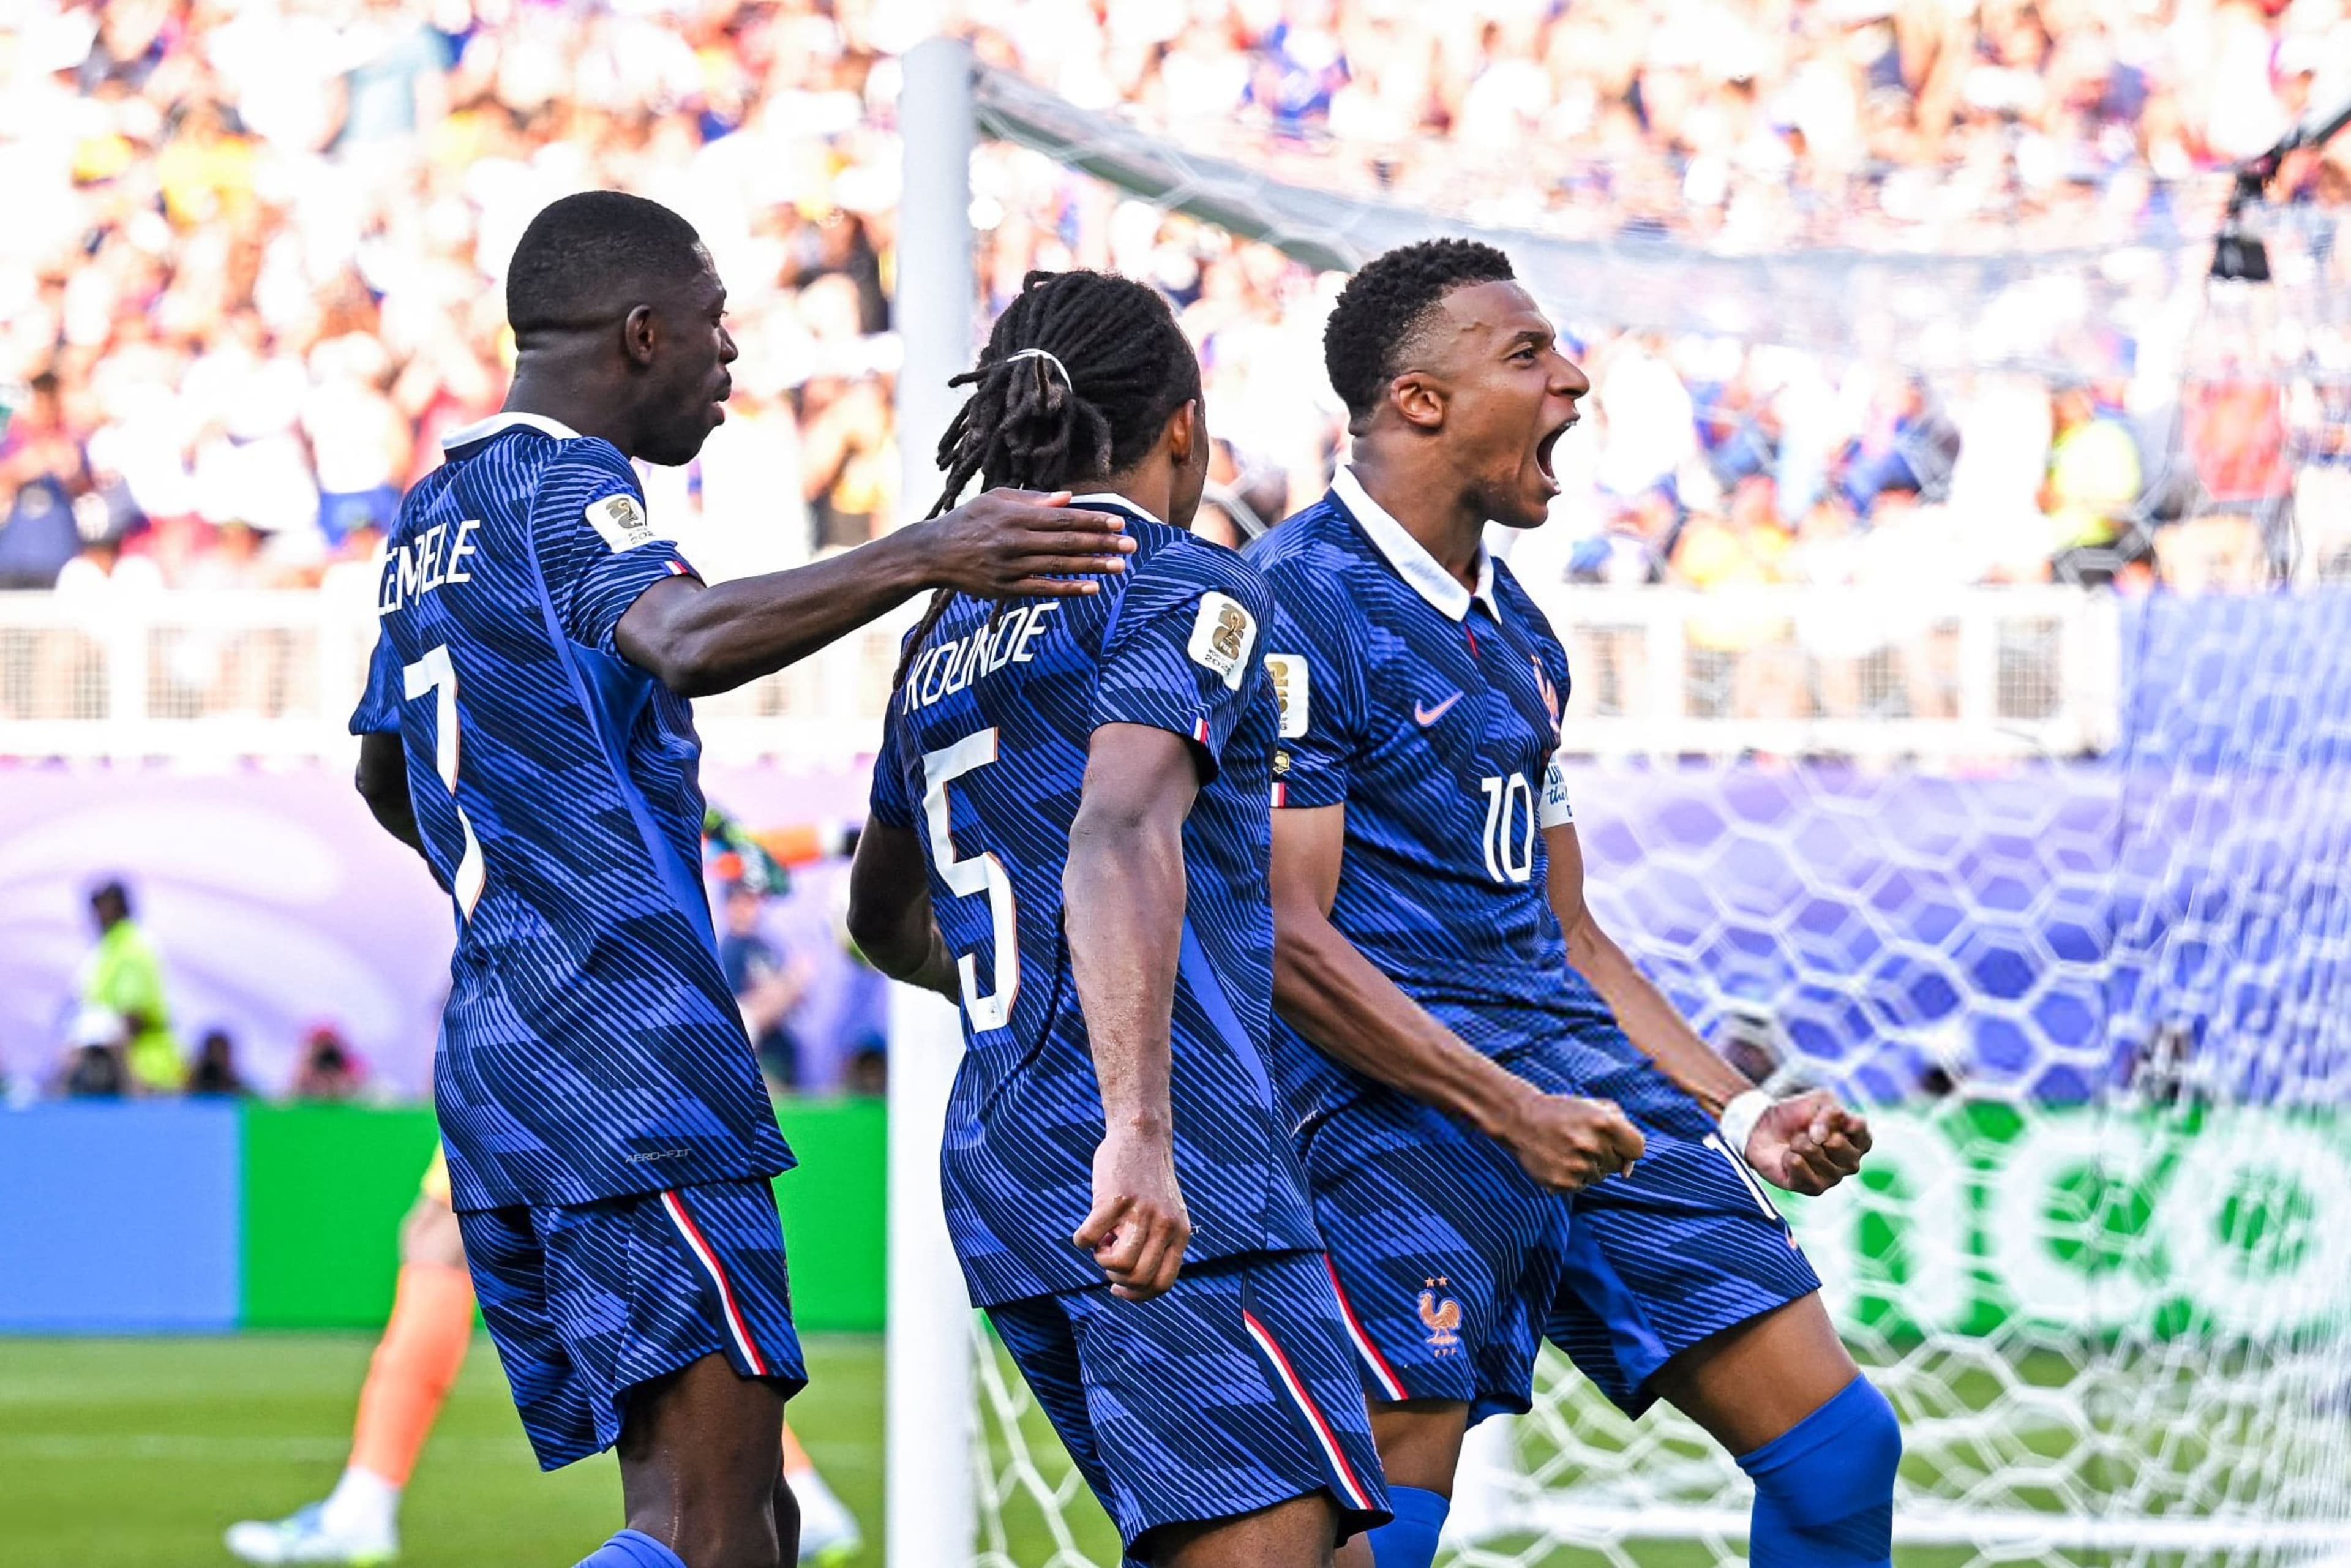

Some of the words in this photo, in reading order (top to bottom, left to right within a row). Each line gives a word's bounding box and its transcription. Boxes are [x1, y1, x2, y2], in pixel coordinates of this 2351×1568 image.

[403, 643, 486, 925] 7
[922, 726, 1021, 1033] 5
[1482, 772, 1535, 883] 10
[1702, 1133, 1779, 1220] 1
